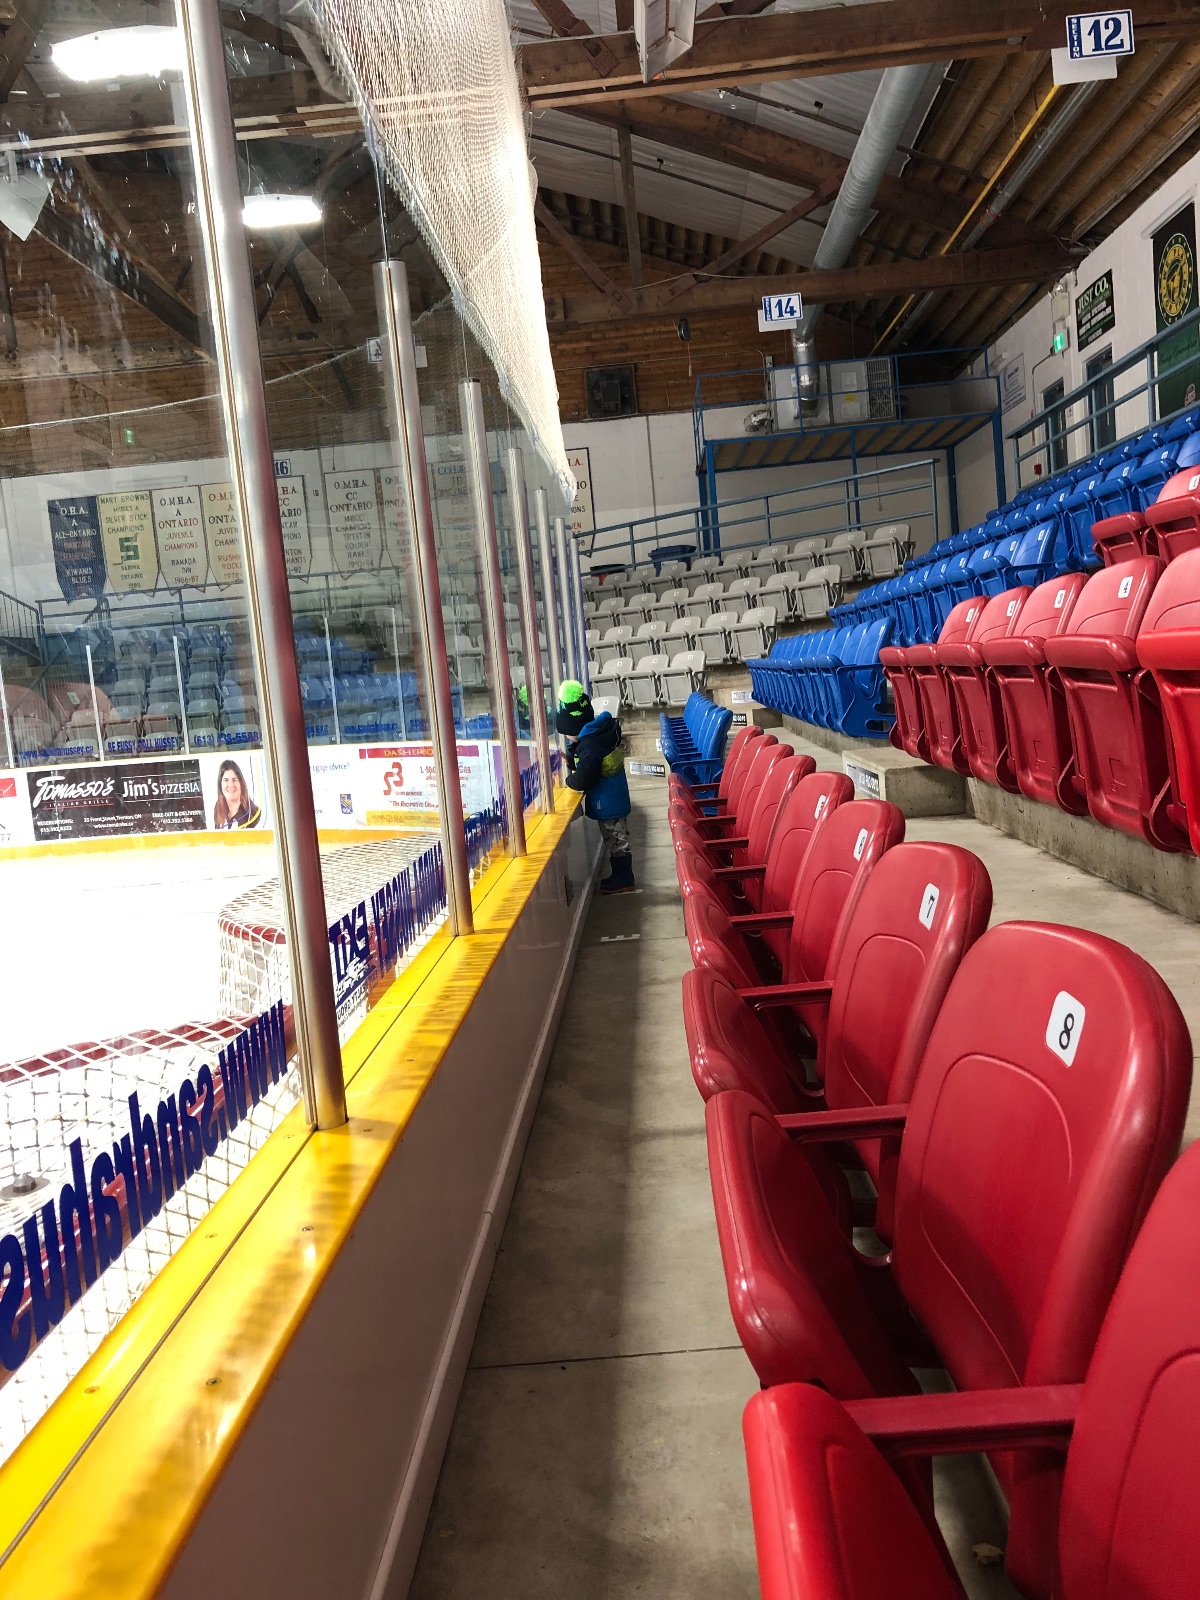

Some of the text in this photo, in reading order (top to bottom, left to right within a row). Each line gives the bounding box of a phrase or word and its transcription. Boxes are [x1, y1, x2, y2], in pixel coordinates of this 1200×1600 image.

[1071, 18, 1080, 57] SECTION
[1087, 17, 1124, 52] 12
[775, 298, 797, 317] 14
[274, 461, 289, 475] 16
[334, 480, 370, 489] O.M.H.A.
[100, 494, 149, 504] MARY BROWNS
[160, 496, 195, 506] O.M.H.A.
[346, 492, 357, 500] CC
[60, 506, 88, 516] O.H.A.
[330, 501, 372, 513] ONTARIO
[106, 513, 148, 523] SILVER STICK
[281, 508, 302, 518] ARIO
[159, 518, 198, 529] ONTARIO
[209, 515, 236, 524] ONTA
[108, 525, 144, 534] CHAMPIONS
[282, 521, 298, 529] NTAM
[336, 523, 371, 532] CHAMPIONS
[55, 529, 97, 539] ALL-ONTARIO
[166, 531, 194, 539] JUVENILE
[165, 542, 198, 551] CHAMPIONS
[171, 558, 196, 566] RAMADA
[72, 576, 92, 584] BLUES
[108, 741, 116, 752] BE
[117, 740, 136, 752] FUSSY
[155, 737, 179, 749] HUSSEY
[194, 733, 214, 747] (613)
[123, 778, 200, 797] Jim's PIZZERIA
[927, 894, 935, 918] 7
[1059, 1013, 1074, 1050] 8
